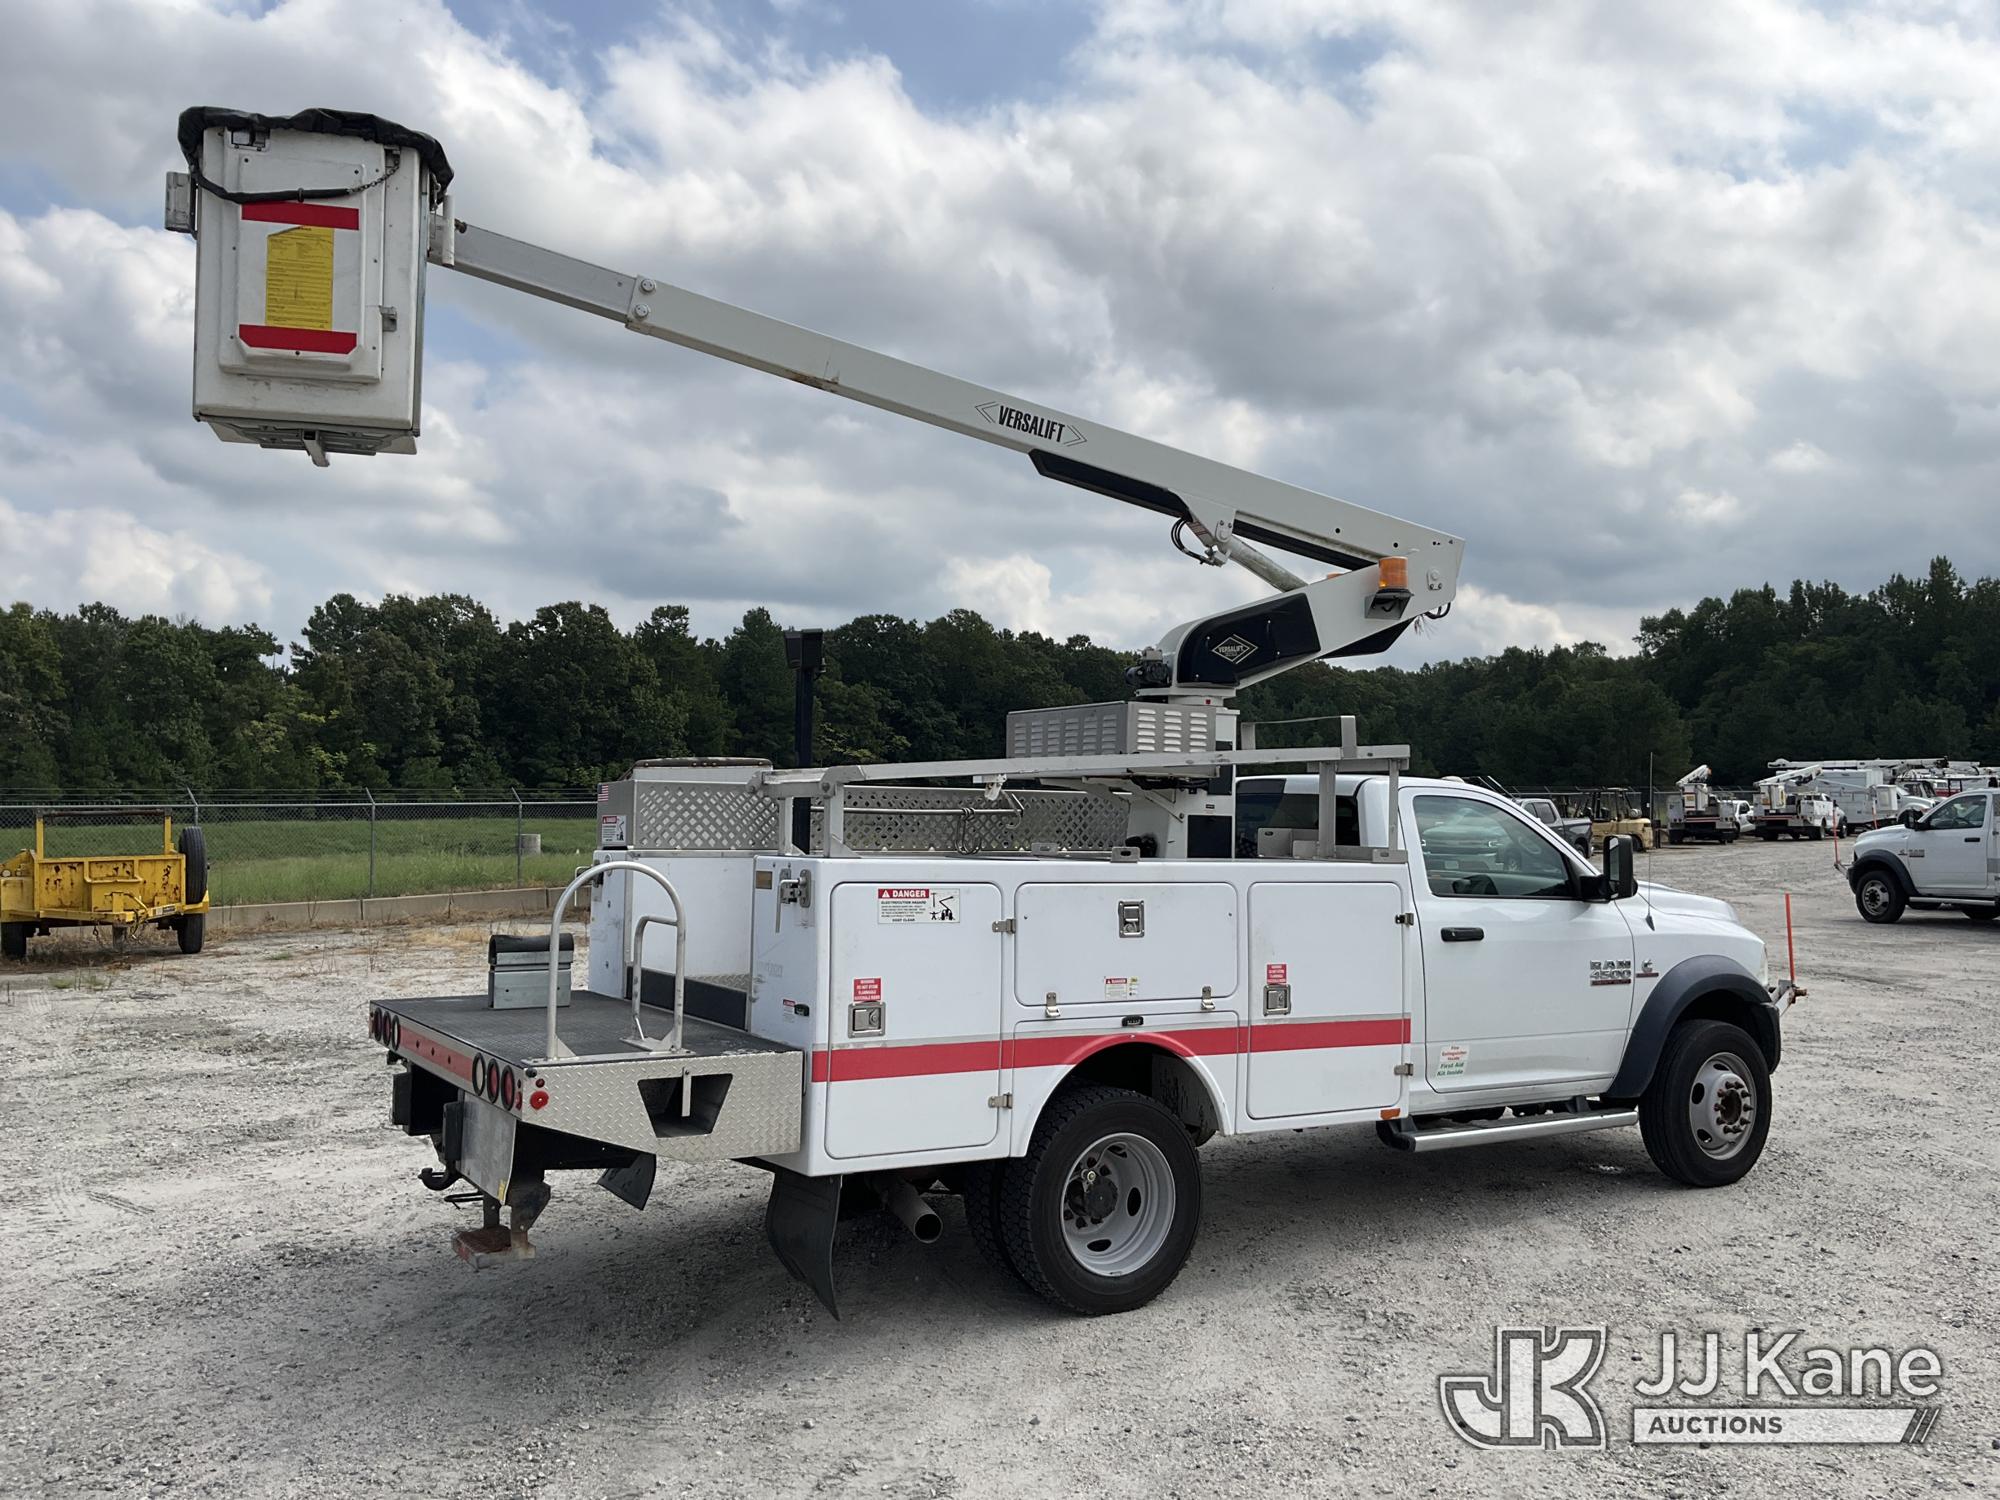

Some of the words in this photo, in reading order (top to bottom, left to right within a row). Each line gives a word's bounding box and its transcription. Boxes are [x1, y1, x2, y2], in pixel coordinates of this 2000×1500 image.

[998, 405, 1066, 442] VERSALIFT
[892, 890, 926, 898] DANGER
[1590, 960, 1631, 970] RAM
[1590, 969, 1631, 980] 4500
